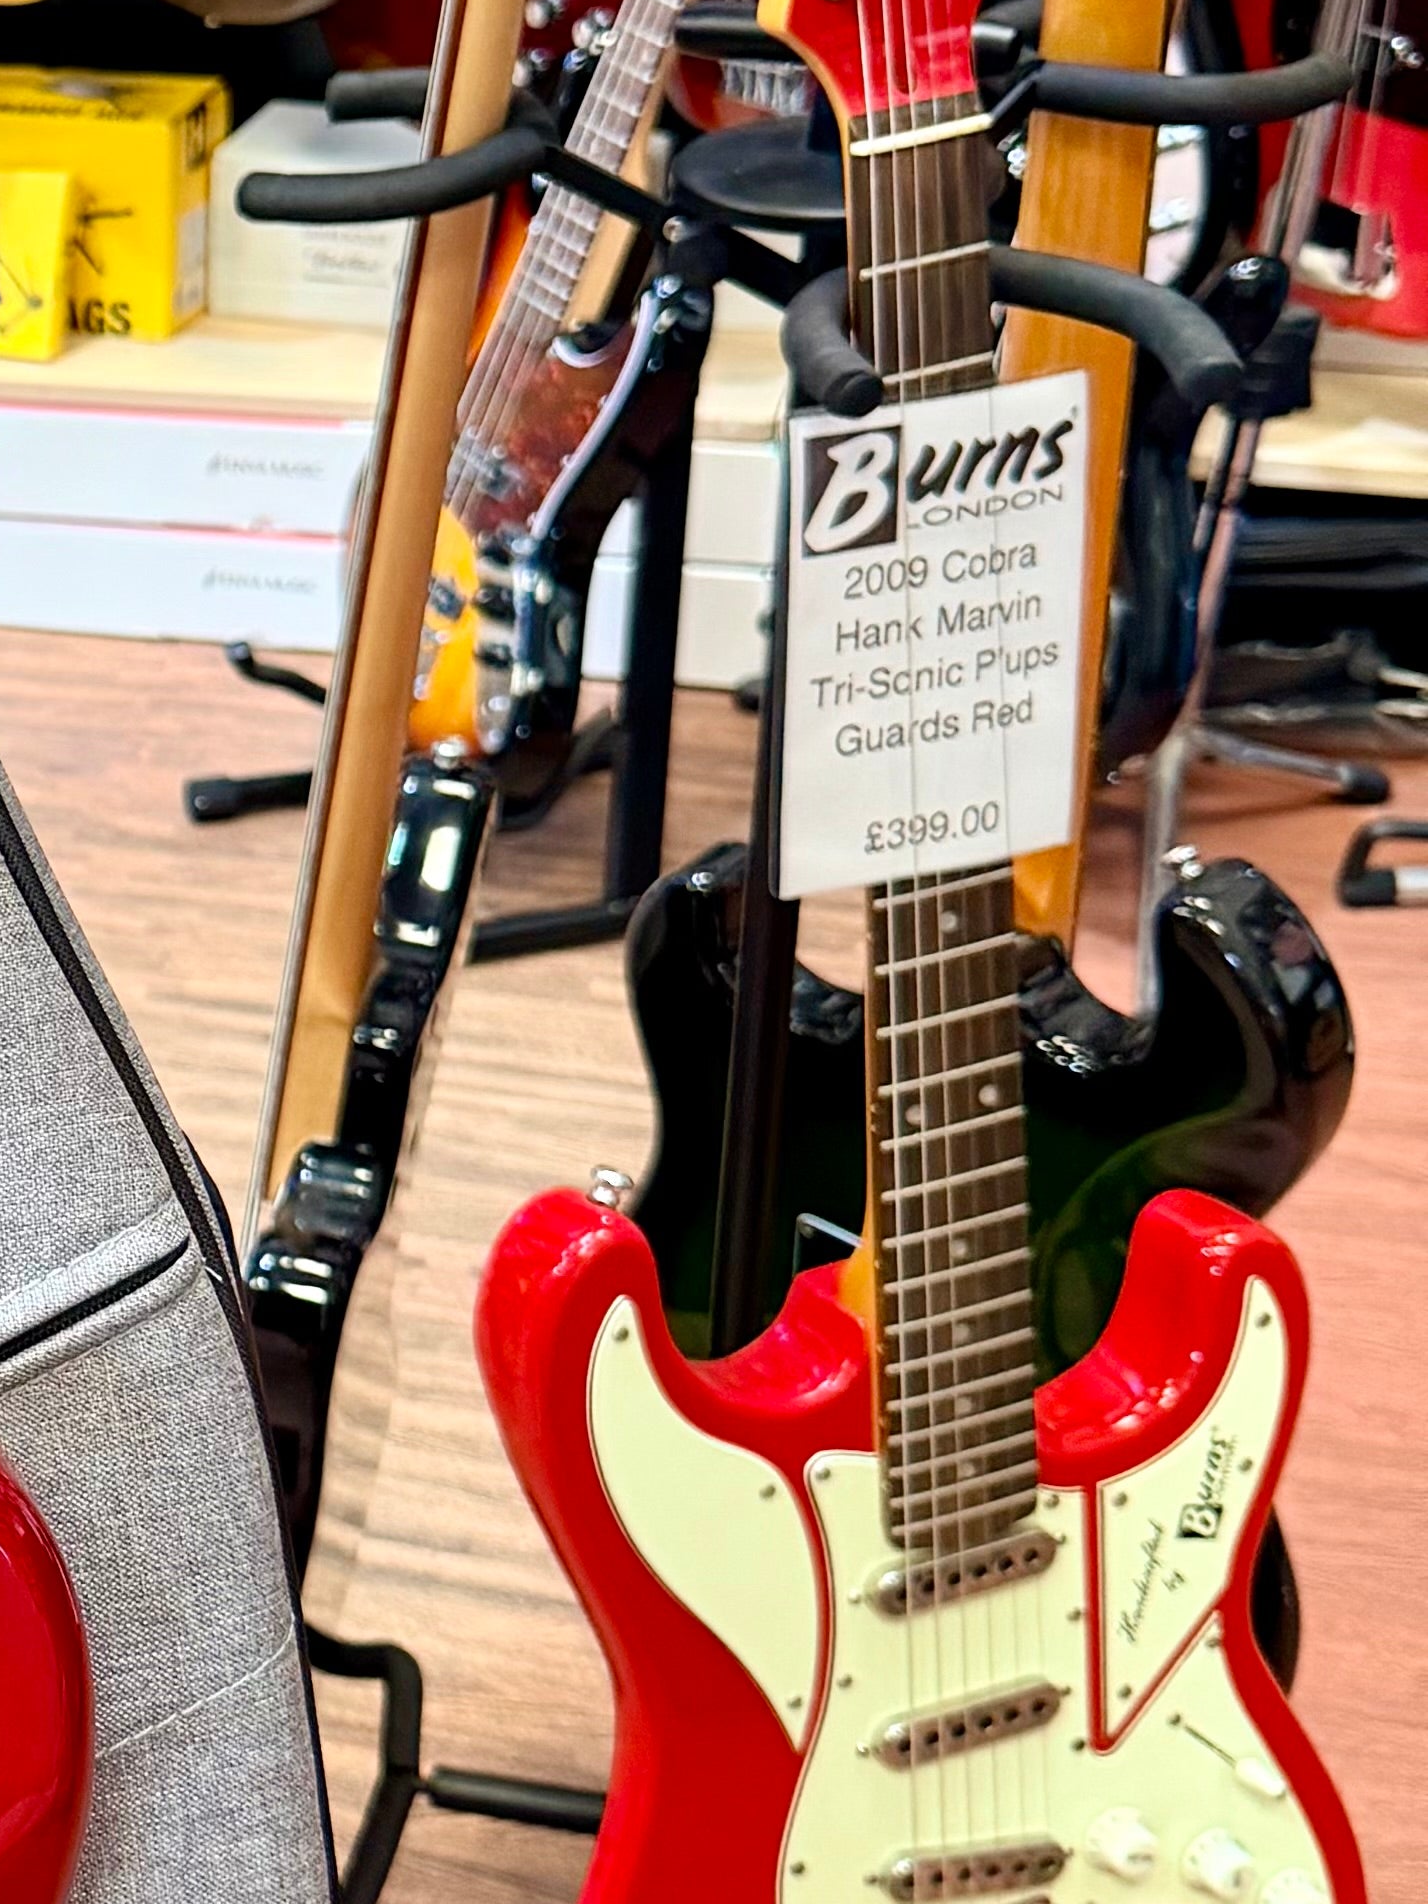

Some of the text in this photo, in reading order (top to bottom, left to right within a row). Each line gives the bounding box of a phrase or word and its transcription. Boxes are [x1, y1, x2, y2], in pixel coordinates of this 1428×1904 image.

[802, 420, 1075, 557] Burns
[906, 483, 1065, 530] LONDON
[844, 542, 1037, 600] 2009 Cobra
[835, 592, 1042, 654] Hank Marvin
[810, 658, 965, 709] Tri-Sonic
[834, 691, 1034, 757] Guards Red
[863, 800, 1001, 855] £399.00
[1176, 1425, 1229, 1539] Burns
